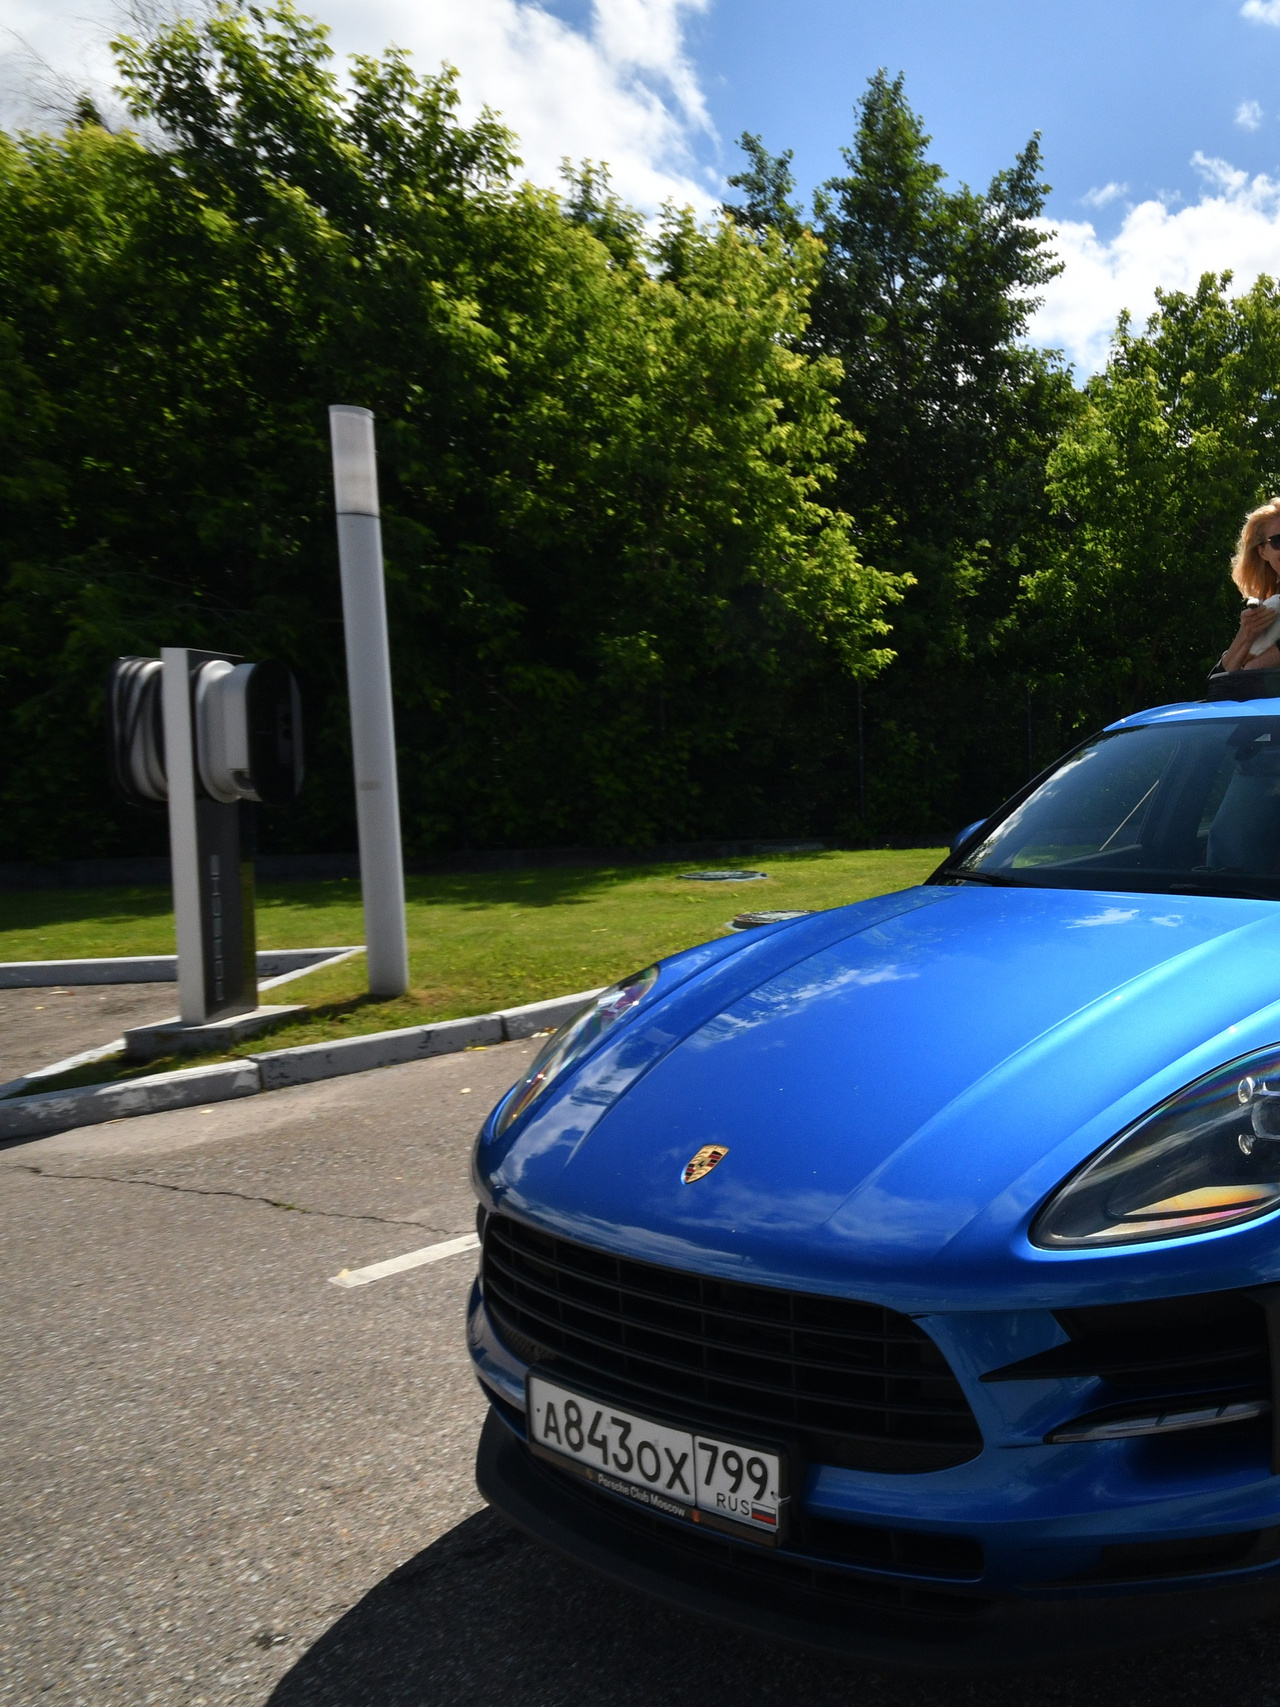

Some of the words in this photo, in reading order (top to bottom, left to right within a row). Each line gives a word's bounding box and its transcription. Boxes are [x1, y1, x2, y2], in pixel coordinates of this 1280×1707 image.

[698, 1441, 768, 1500] 799
[597, 1473, 629, 1496] Porsche
[630, 1486, 649, 1503] Club
[650, 1493, 685, 1517] Moscow
[716, 1492, 750, 1516] RUS
